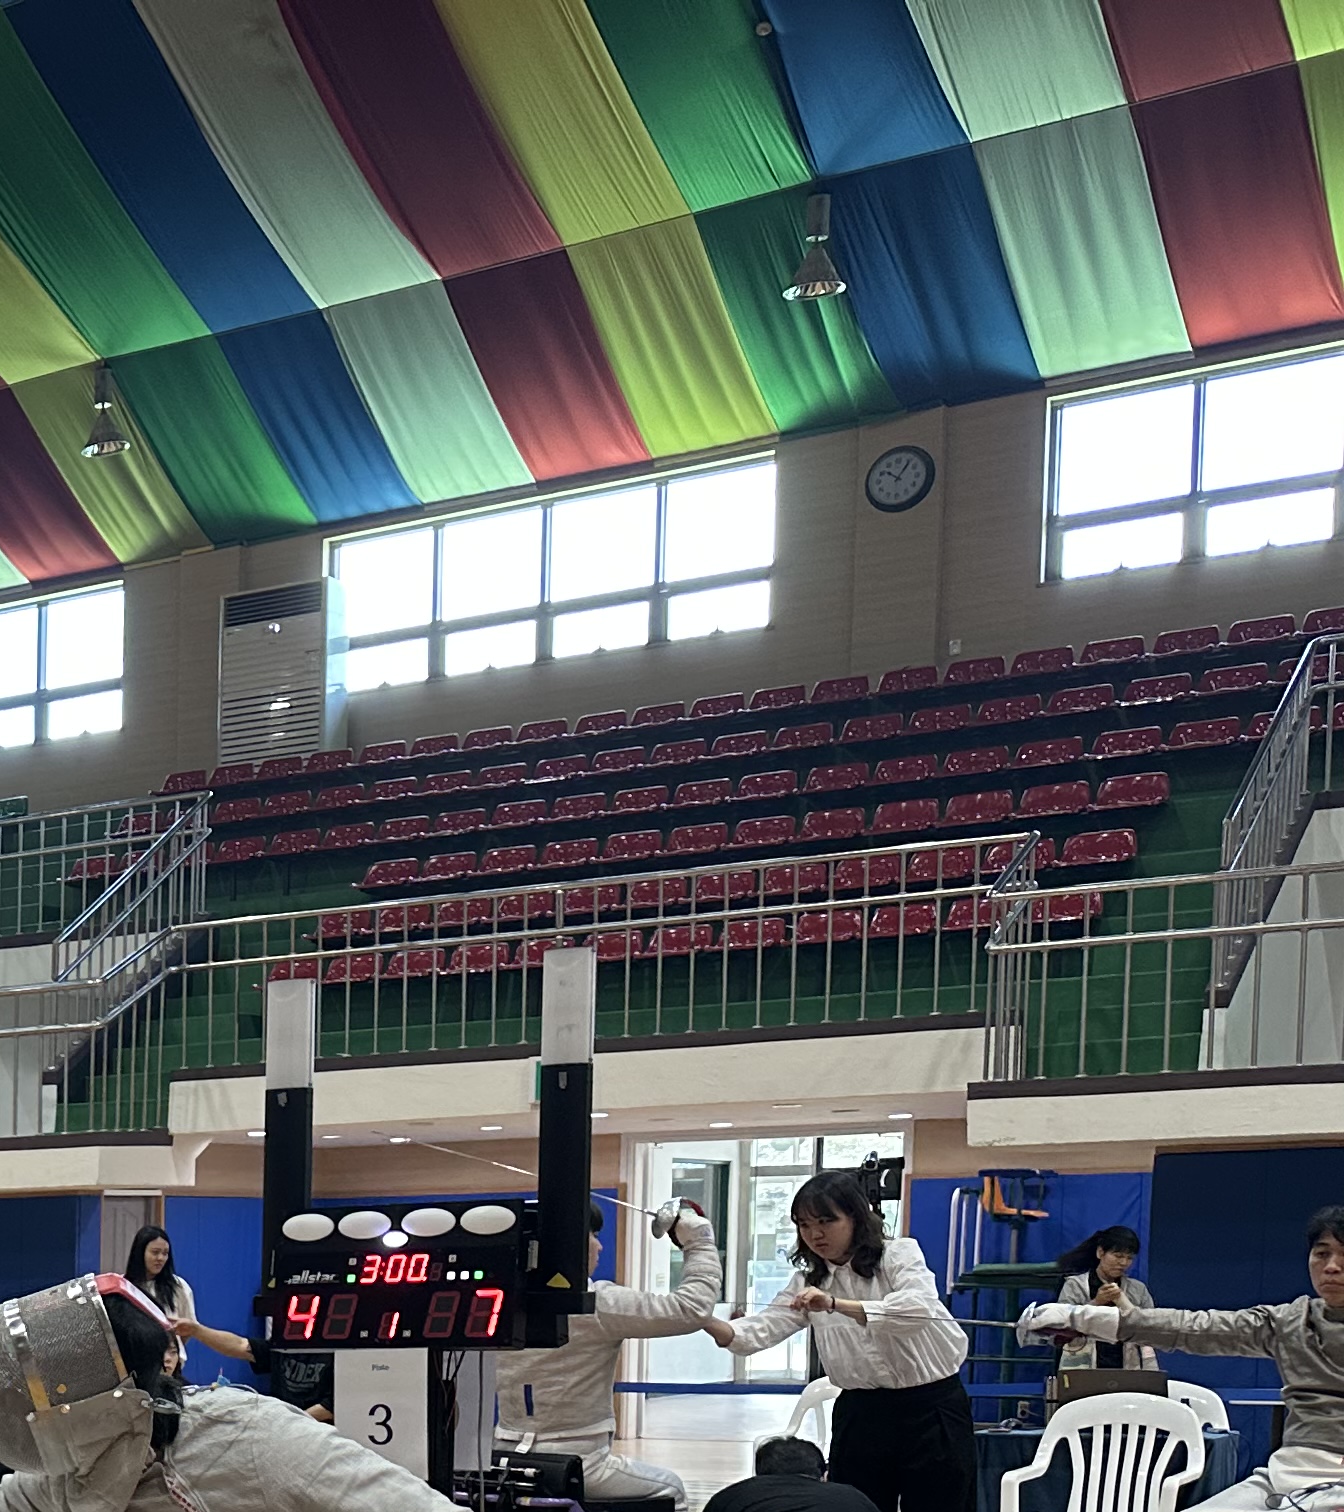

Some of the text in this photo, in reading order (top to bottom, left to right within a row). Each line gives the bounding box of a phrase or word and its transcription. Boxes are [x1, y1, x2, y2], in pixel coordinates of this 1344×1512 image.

[290, 1270, 335, 1284] allstar
[287, 1288, 504, 1339] 4 1 7
[367, 1403, 394, 1446] 3
